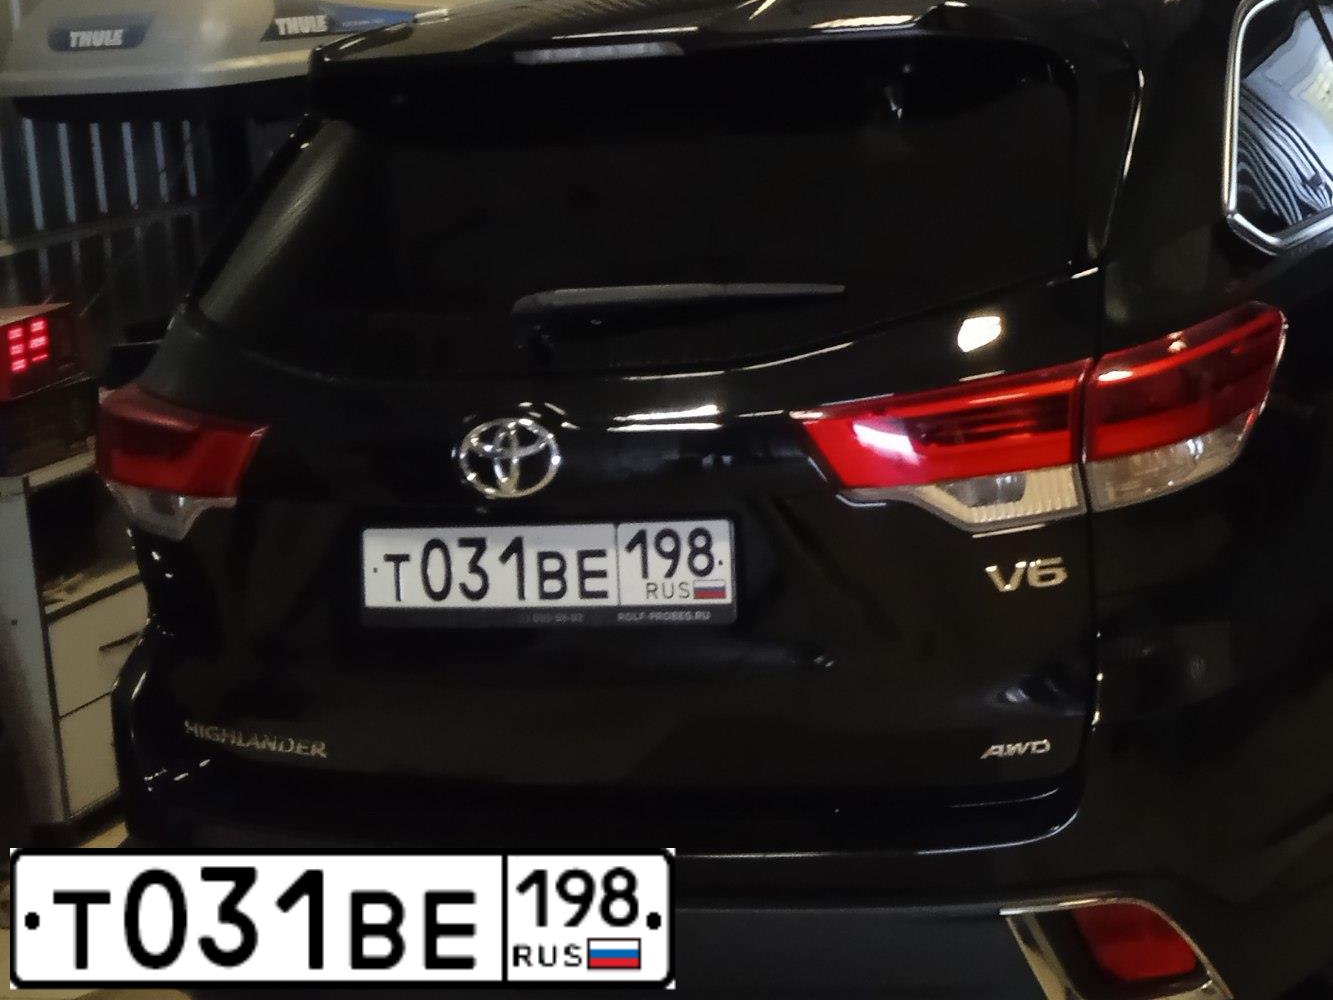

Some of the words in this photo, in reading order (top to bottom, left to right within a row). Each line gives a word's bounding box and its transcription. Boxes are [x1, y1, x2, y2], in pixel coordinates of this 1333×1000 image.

[274, 14, 328, 36] THULE
[69, 28, 124, 48] THULE
[625, 527, 714, 580] 198
[985, 556, 1069, 592] V6
[646, 581, 690, 600] RUS
[184, 719, 327, 759] HIGHLANDER
[980, 738, 1051, 760] AWD
